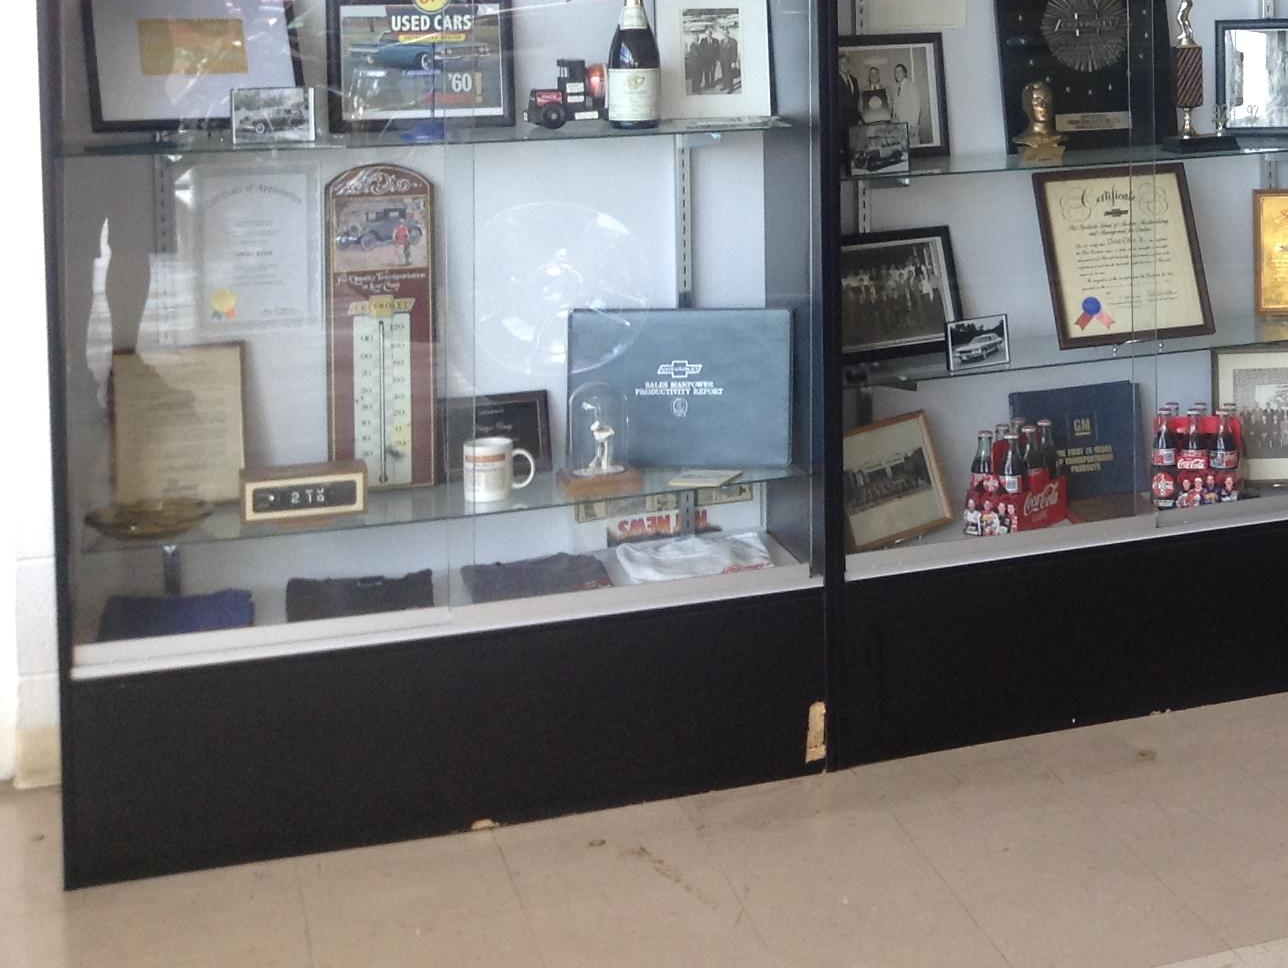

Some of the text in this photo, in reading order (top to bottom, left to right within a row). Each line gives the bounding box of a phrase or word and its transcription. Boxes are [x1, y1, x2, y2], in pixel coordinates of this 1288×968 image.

[391, 14, 472, 32] USED CARS
[635, 387, 724, 396] PRODUCTIVITY REPORT
[645, 381, 714, 389] SALES MANPOWER
[1073, 418, 1092, 433] GM
[1023, 482, 1060, 517] Coca-Cola
[617, 513, 671, 537] NEWS
